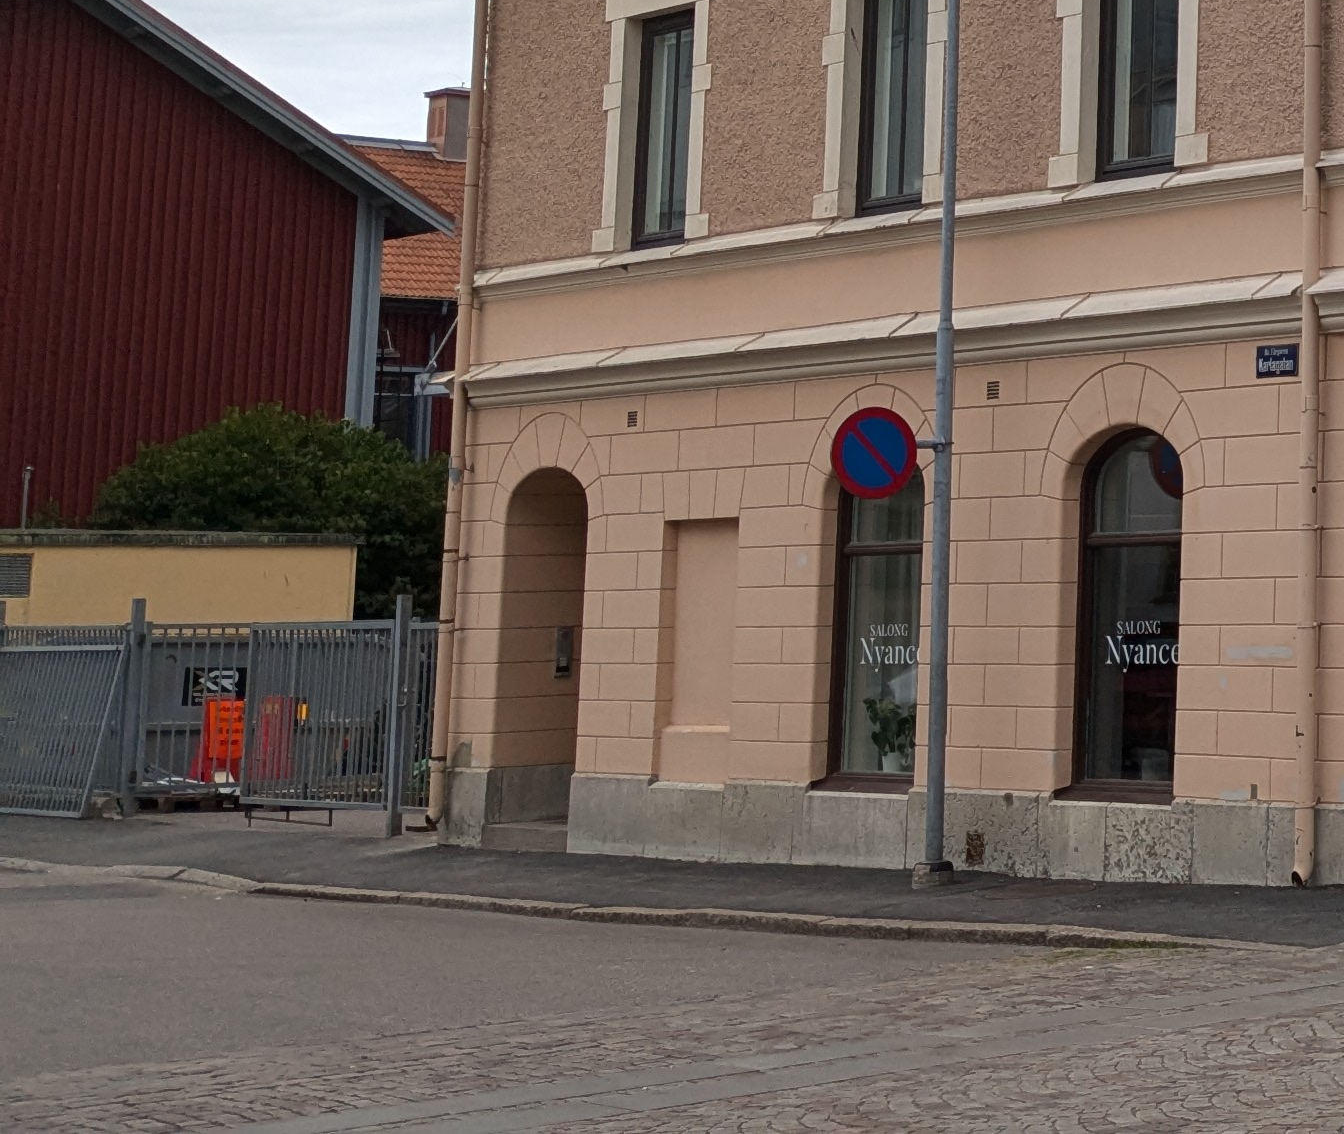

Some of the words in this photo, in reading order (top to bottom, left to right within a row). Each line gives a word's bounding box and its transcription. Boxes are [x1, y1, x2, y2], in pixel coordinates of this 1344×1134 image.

[869, 623, 909, 637] SALONG
[1116, 620, 1161, 635] SALONG
[1105, 635, 1180, 673] Nyance
